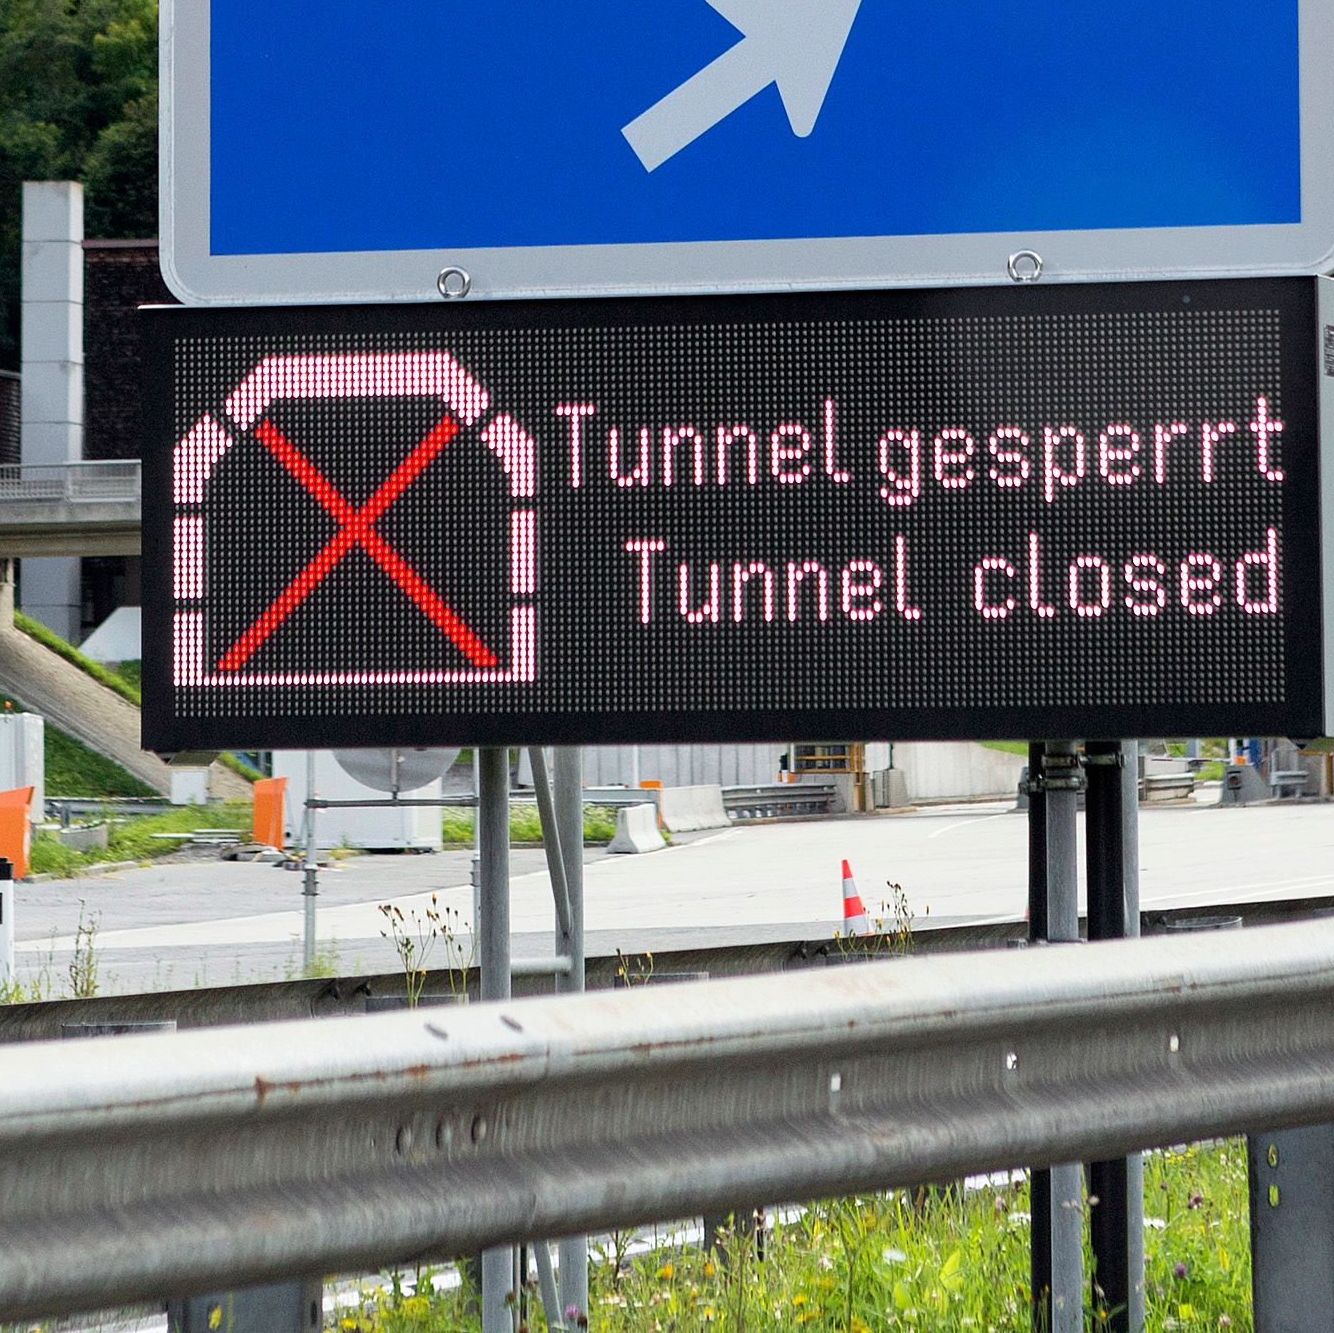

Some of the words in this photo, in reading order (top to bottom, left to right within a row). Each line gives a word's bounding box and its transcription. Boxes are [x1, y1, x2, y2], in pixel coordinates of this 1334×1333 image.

[556, 399, 850, 489] Tunnel
[879, 396, 1285, 507] gesperrt
[625, 535, 922, 625] Tunnel
[974, 528, 1278, 619] closed
